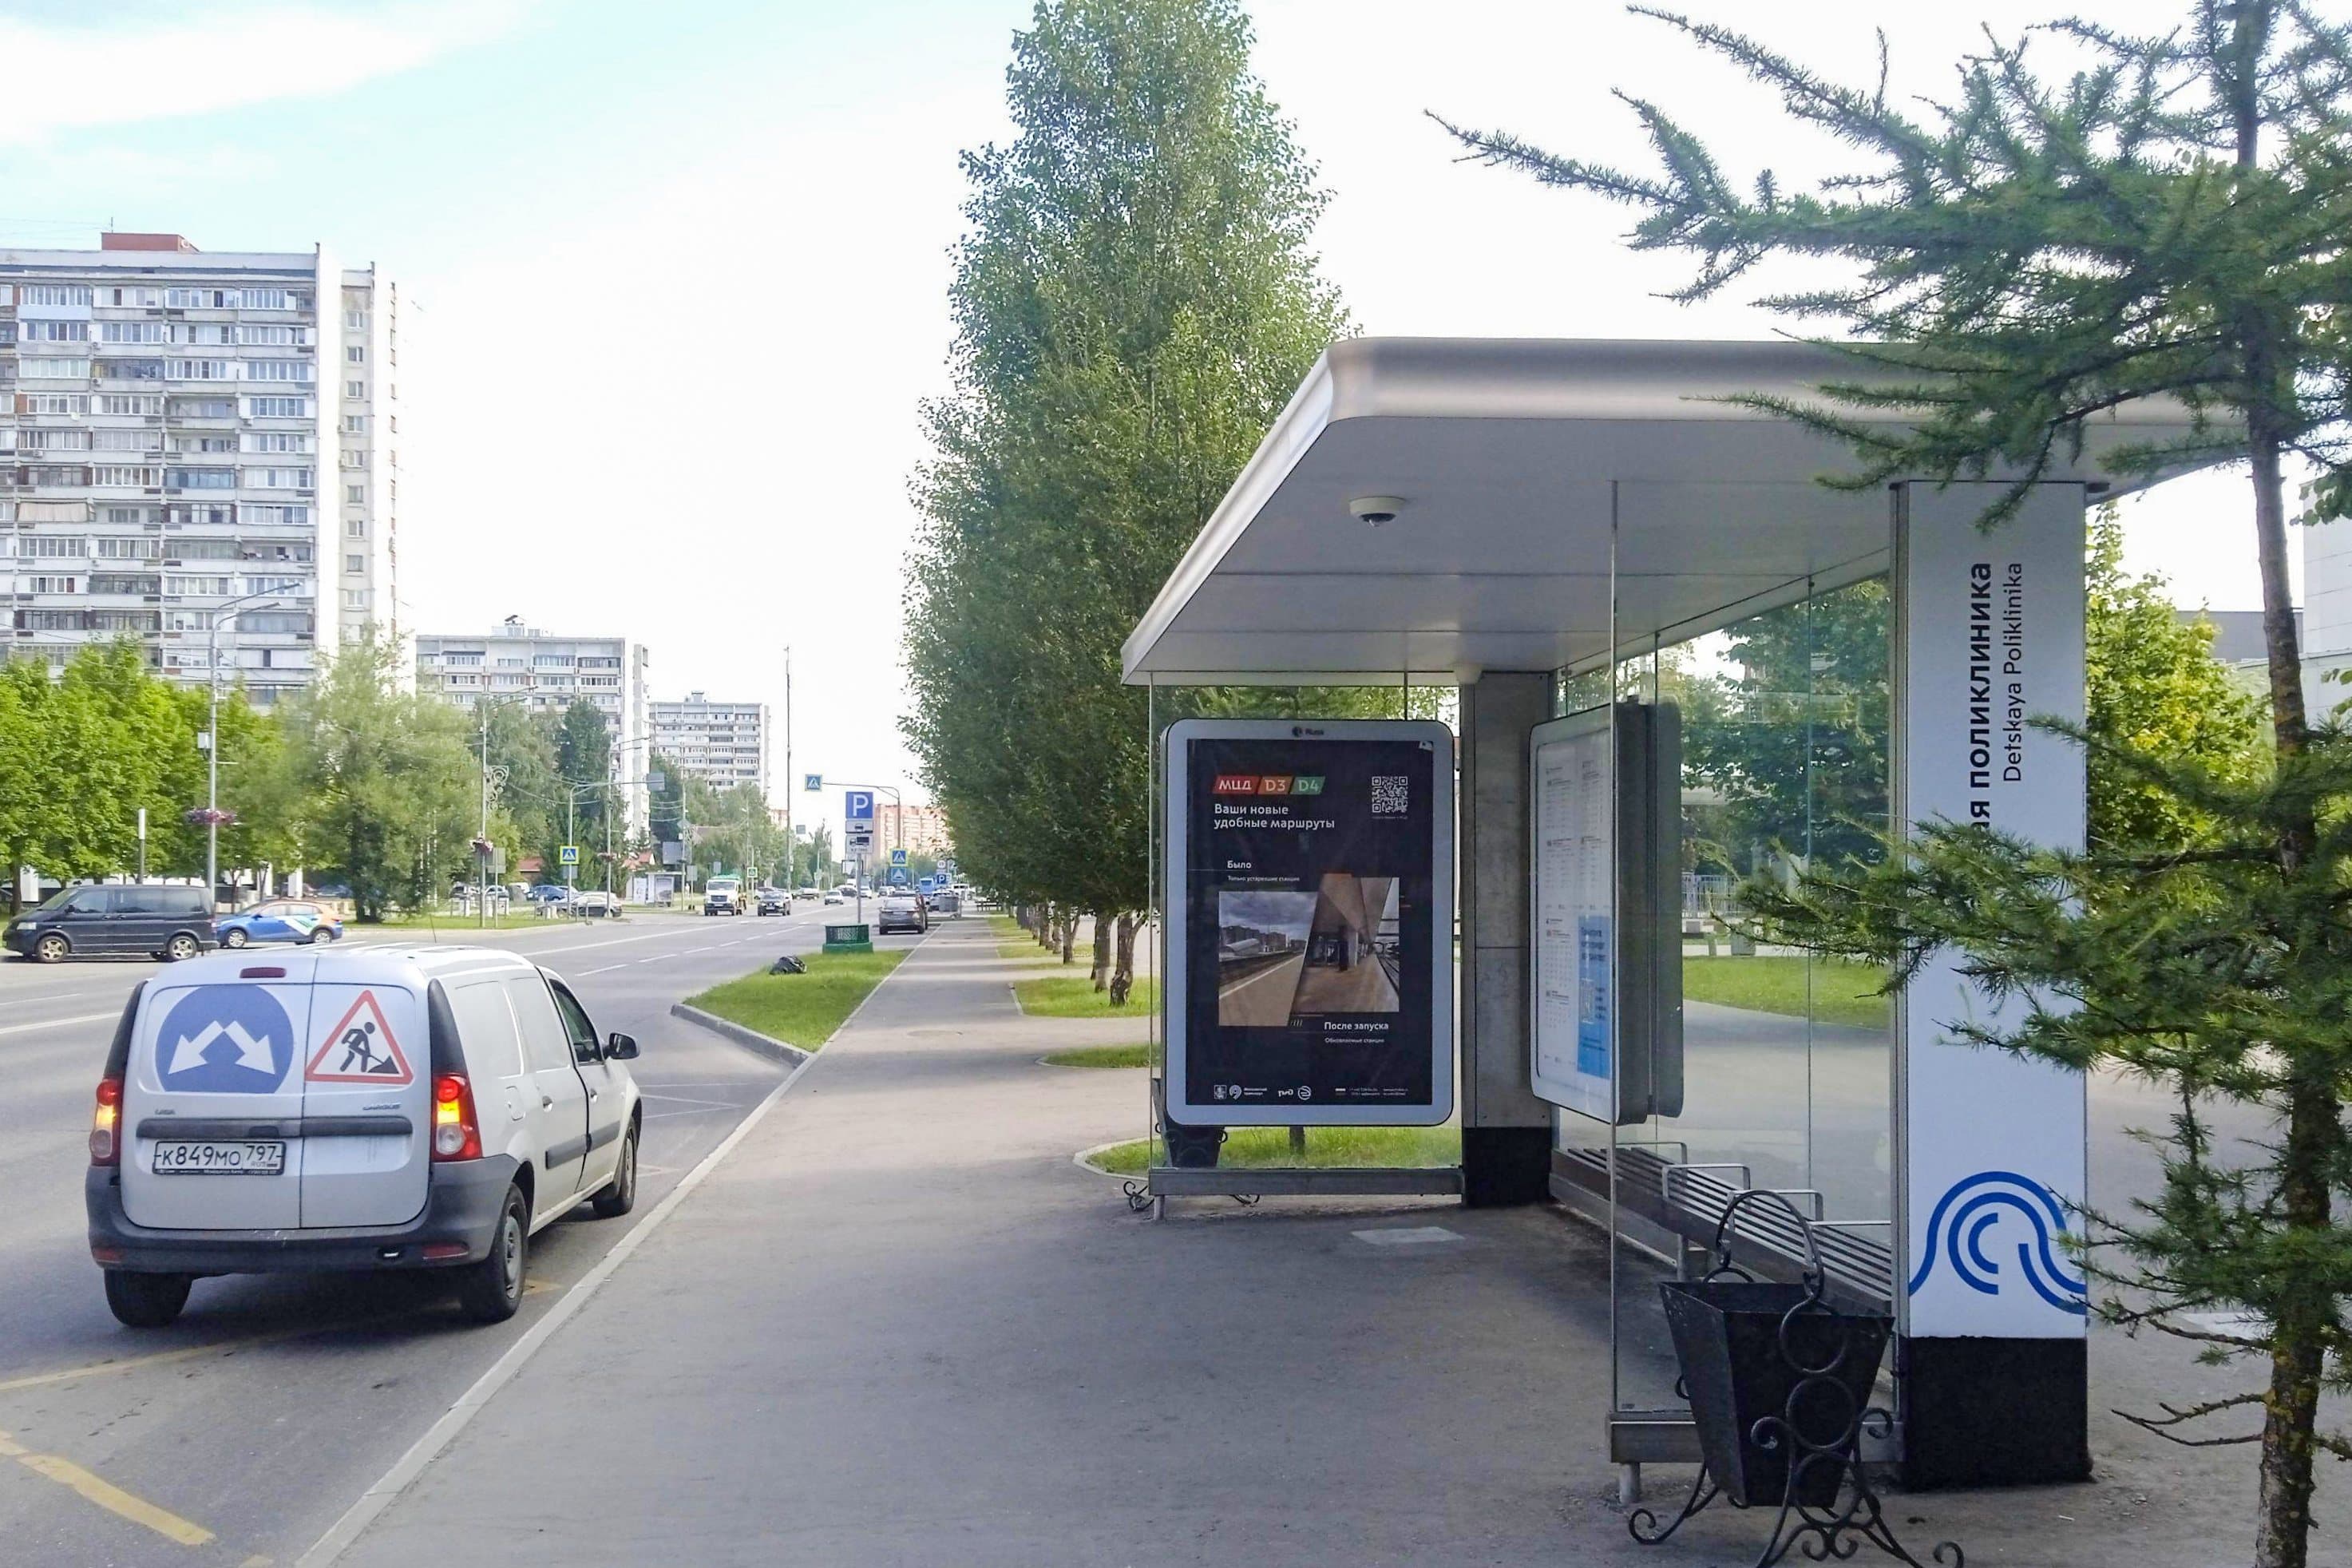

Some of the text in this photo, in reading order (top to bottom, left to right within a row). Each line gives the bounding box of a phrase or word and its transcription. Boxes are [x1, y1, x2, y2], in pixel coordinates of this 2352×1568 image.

[1970, 563, 1991, 788] поликлиника
[2003, 563, 2025, 781] Detskaya Poliklinika
[1219, 779, 1319, 791] МЦД D3 D4
[853, 794, 869, 817] P
[1214, 803, 1246, 814] Ваши
[1214, 818, 1335, 830] удобные маршруты
[1354, 1023, 1389, 1031] запуска
[246, 1144, 277, 1161] 797
